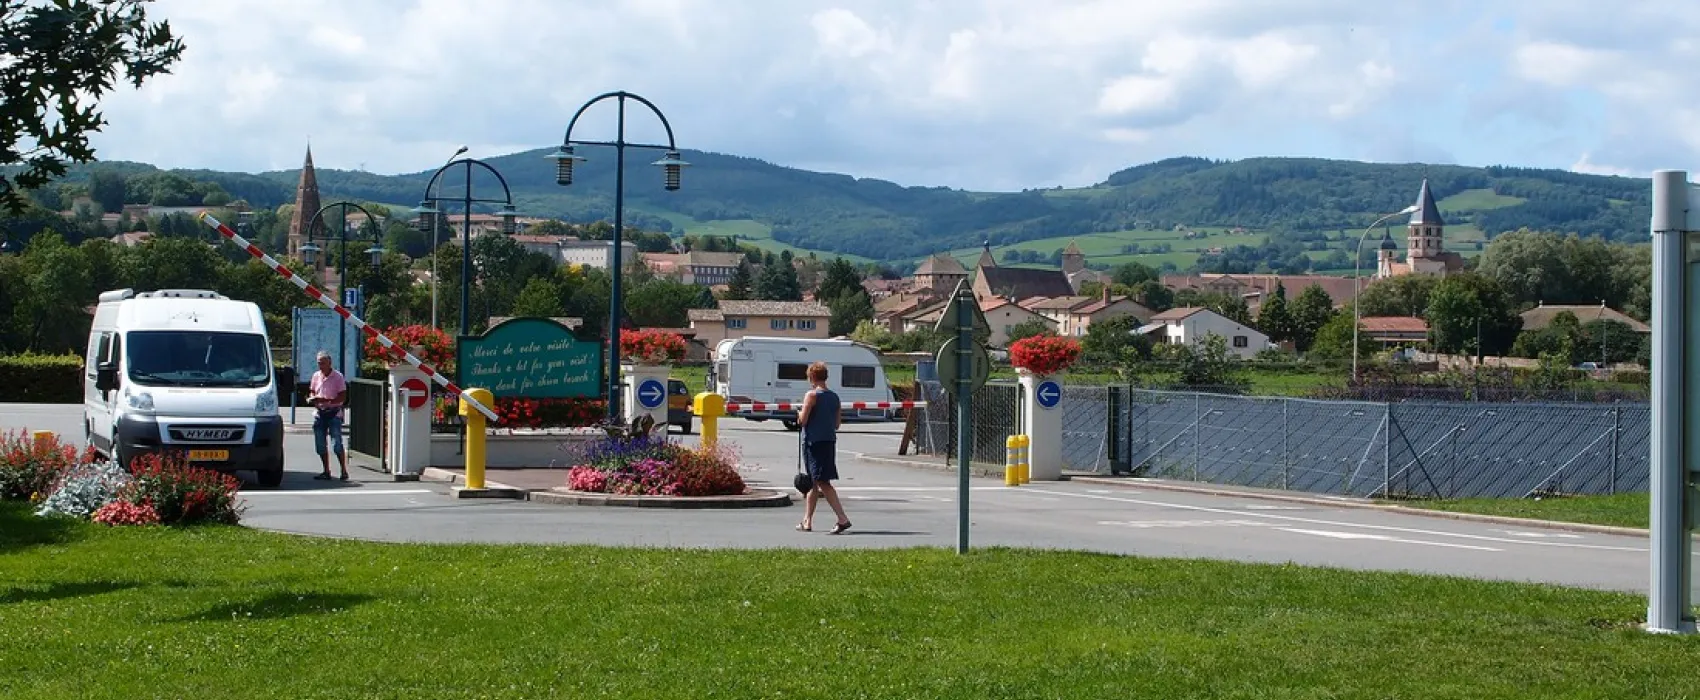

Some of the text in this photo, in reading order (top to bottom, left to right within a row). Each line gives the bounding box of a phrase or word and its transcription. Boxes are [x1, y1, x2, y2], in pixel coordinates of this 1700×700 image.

[470, 345, 498, 358] Merci
[503, 342, 513, 355] de
[520, 341, 541, 353] votre
[471, 362, 501, 375] Thanks
[516, 360, 527, 371] lot
[530, 358, 543, 375] for
[547, 360, 565, 373] your
[496, 379, 516, 391] dank
[187, 429, 230, 439] HYMER
